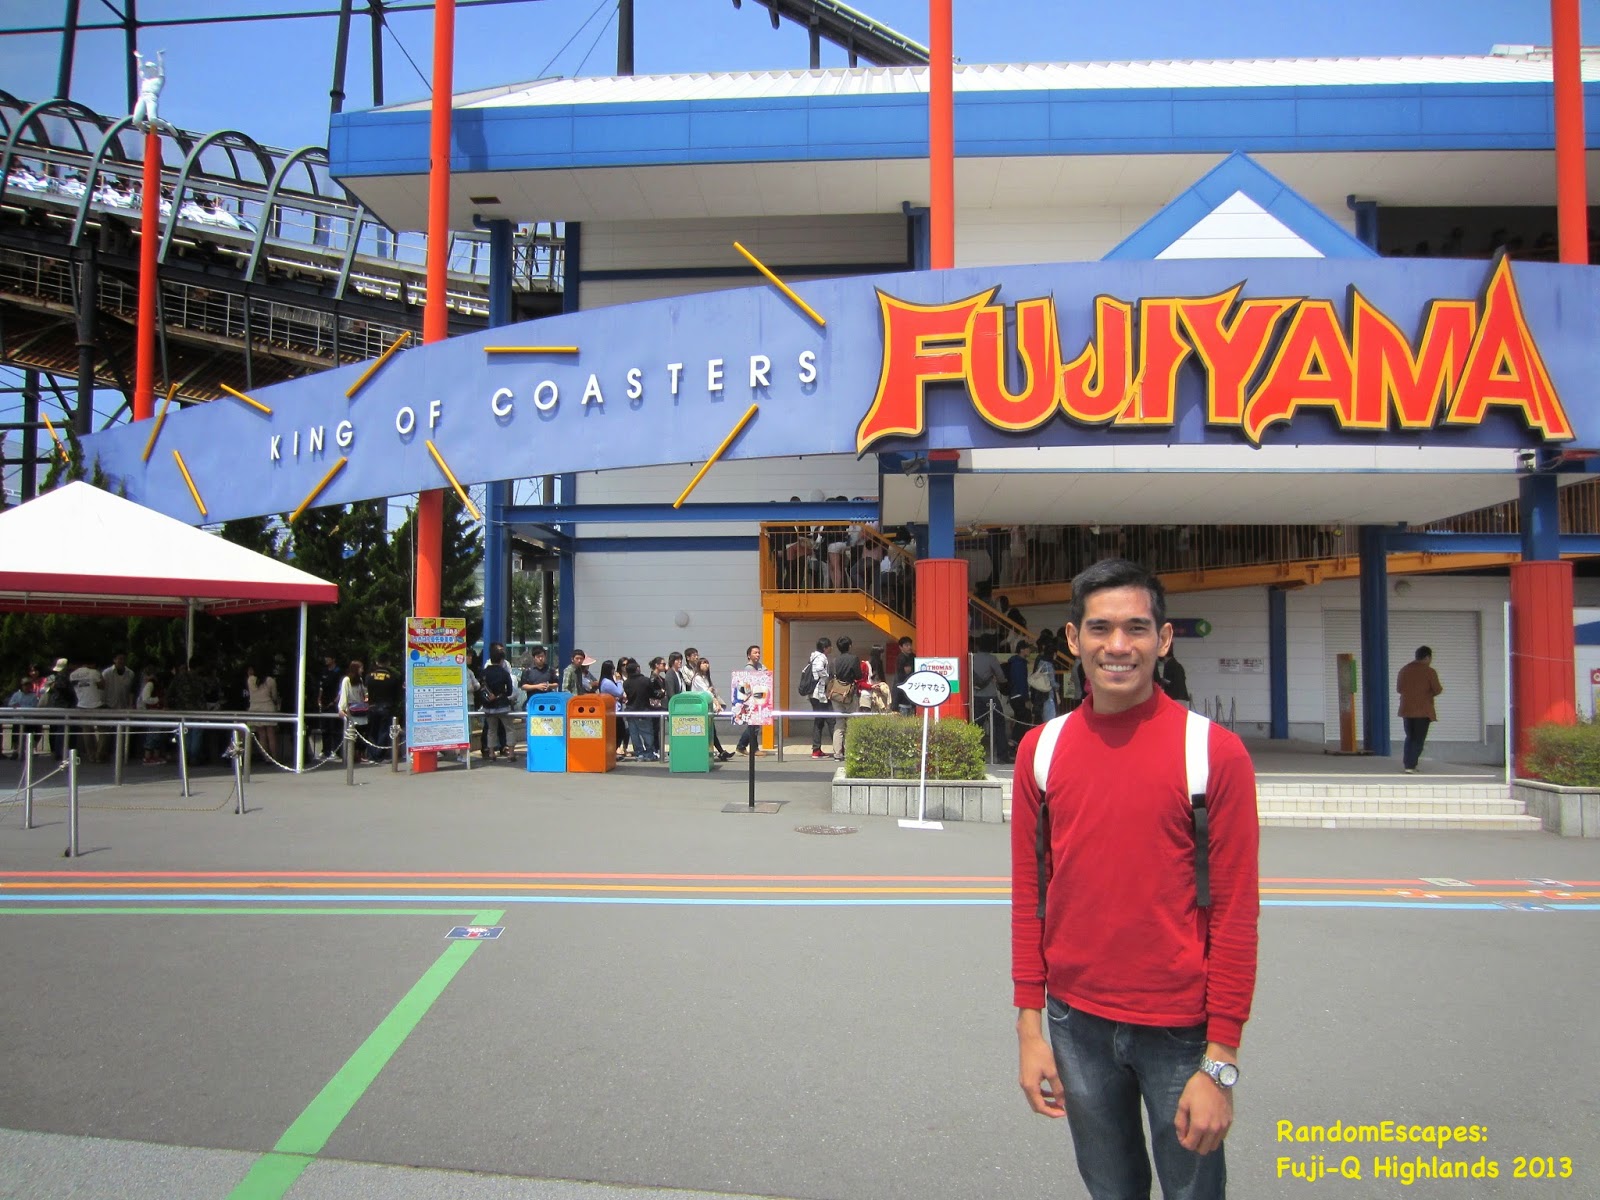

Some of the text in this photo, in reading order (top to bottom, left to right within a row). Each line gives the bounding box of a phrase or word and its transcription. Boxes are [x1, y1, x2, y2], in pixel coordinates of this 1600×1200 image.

[270, 350, 818, 461] KING OF COASTERS
[856, 250, 1576, 458] FUJIYAMA
[908, 682, 946, 692] フジヤマなう
